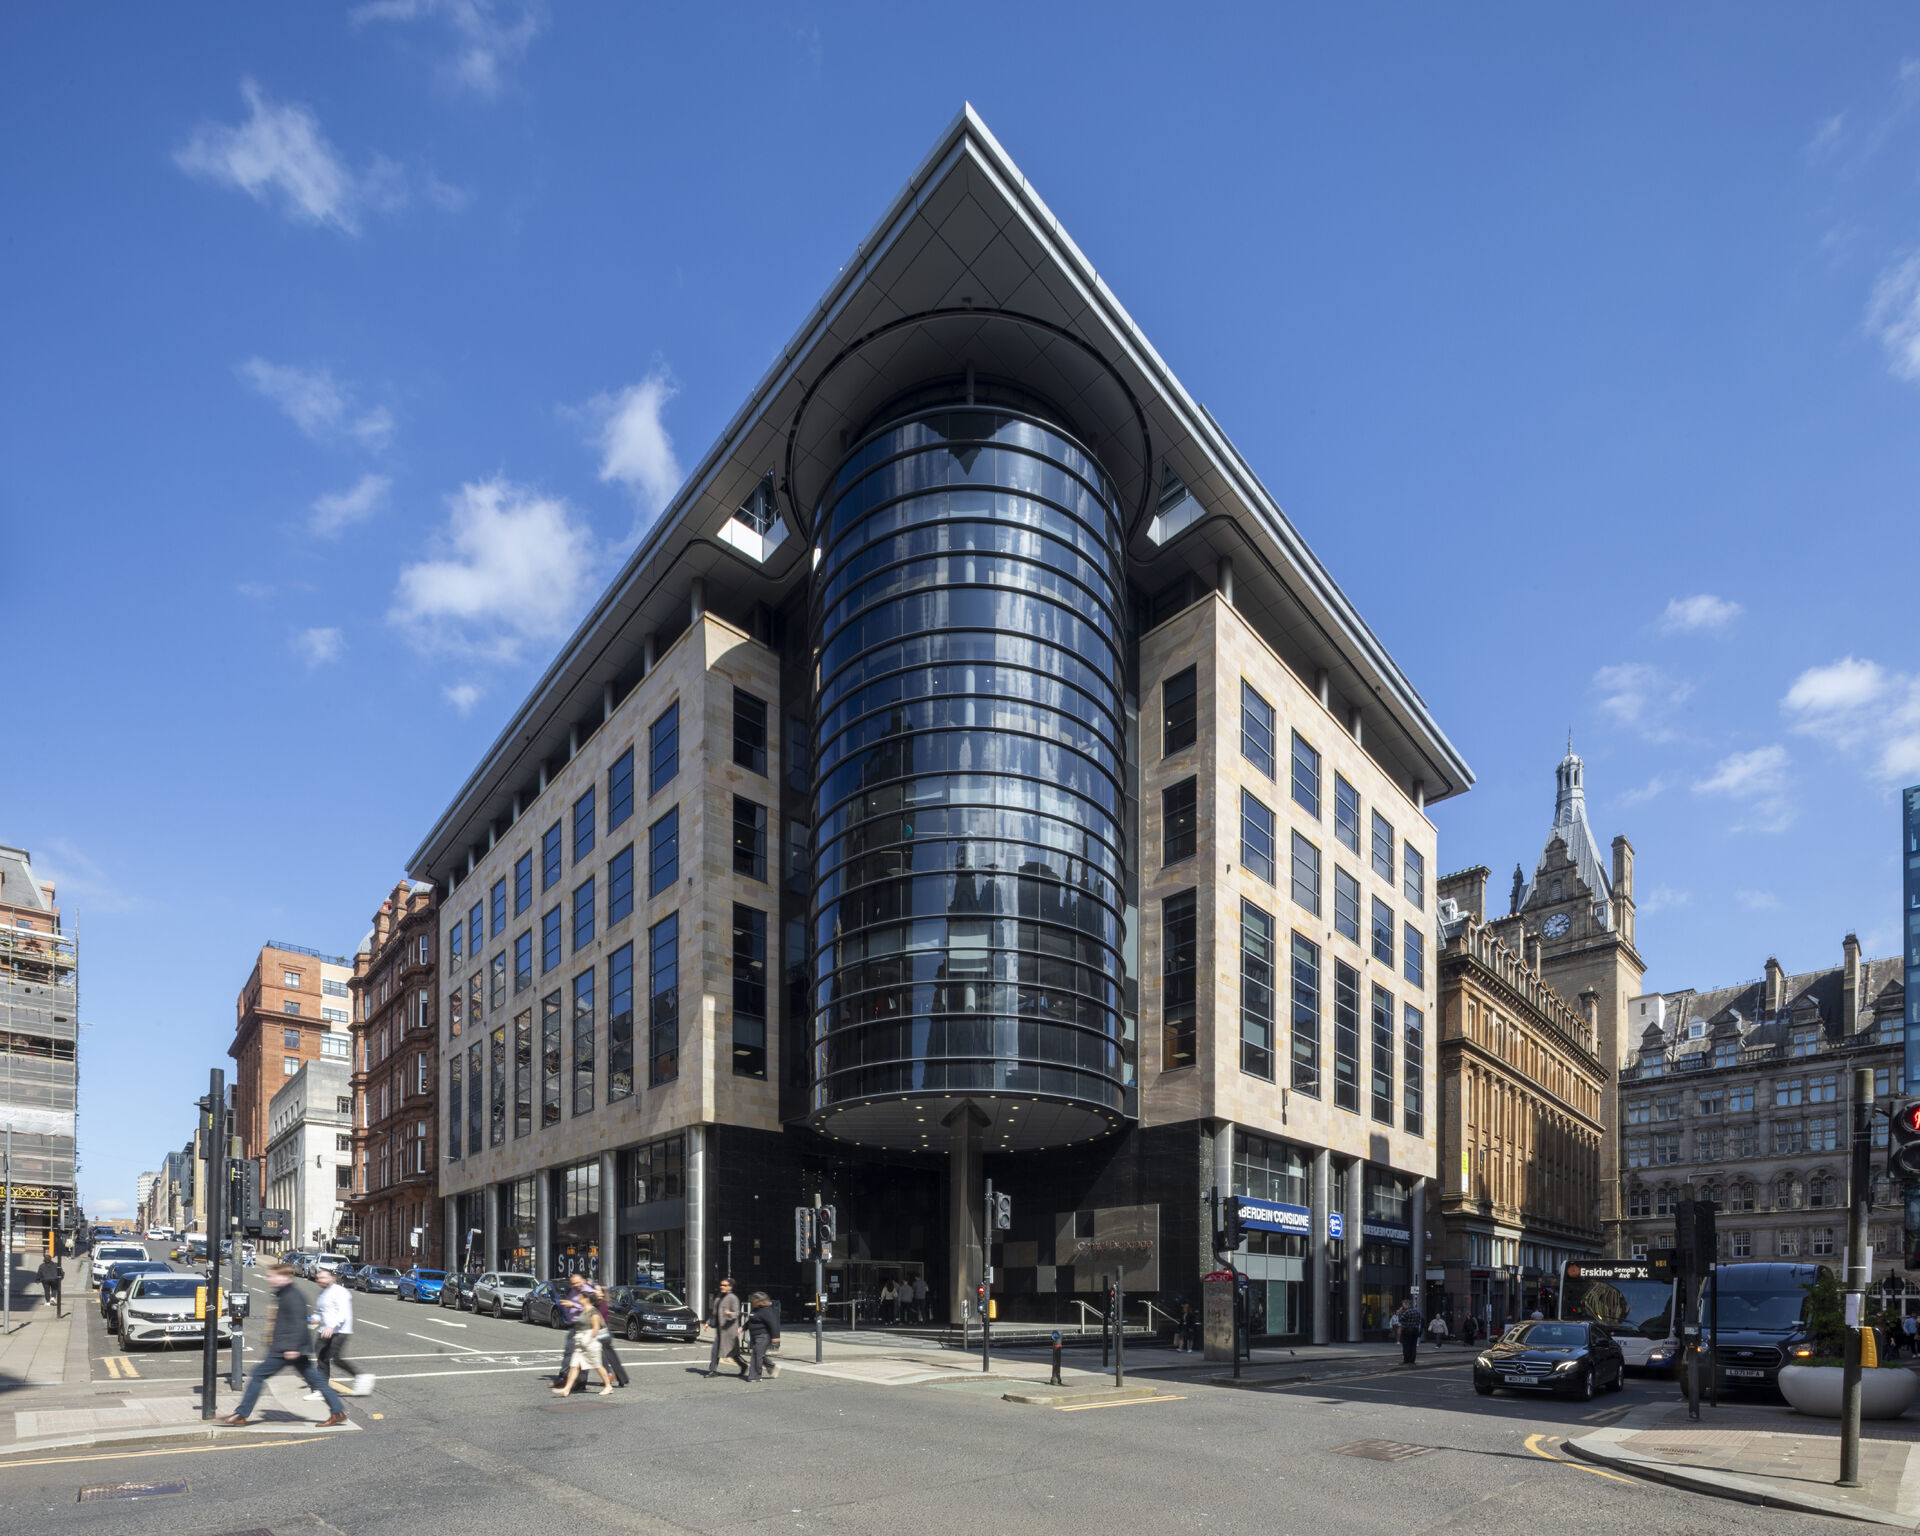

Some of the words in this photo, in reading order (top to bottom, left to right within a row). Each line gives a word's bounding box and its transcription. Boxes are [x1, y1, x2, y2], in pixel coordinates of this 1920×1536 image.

[1273, 1210, 1309, 1227] CONSIDINE
[1363, 1224, 1386, 1237] BERDEIN
[1580, 1267, 1614, 1277] Erskine
